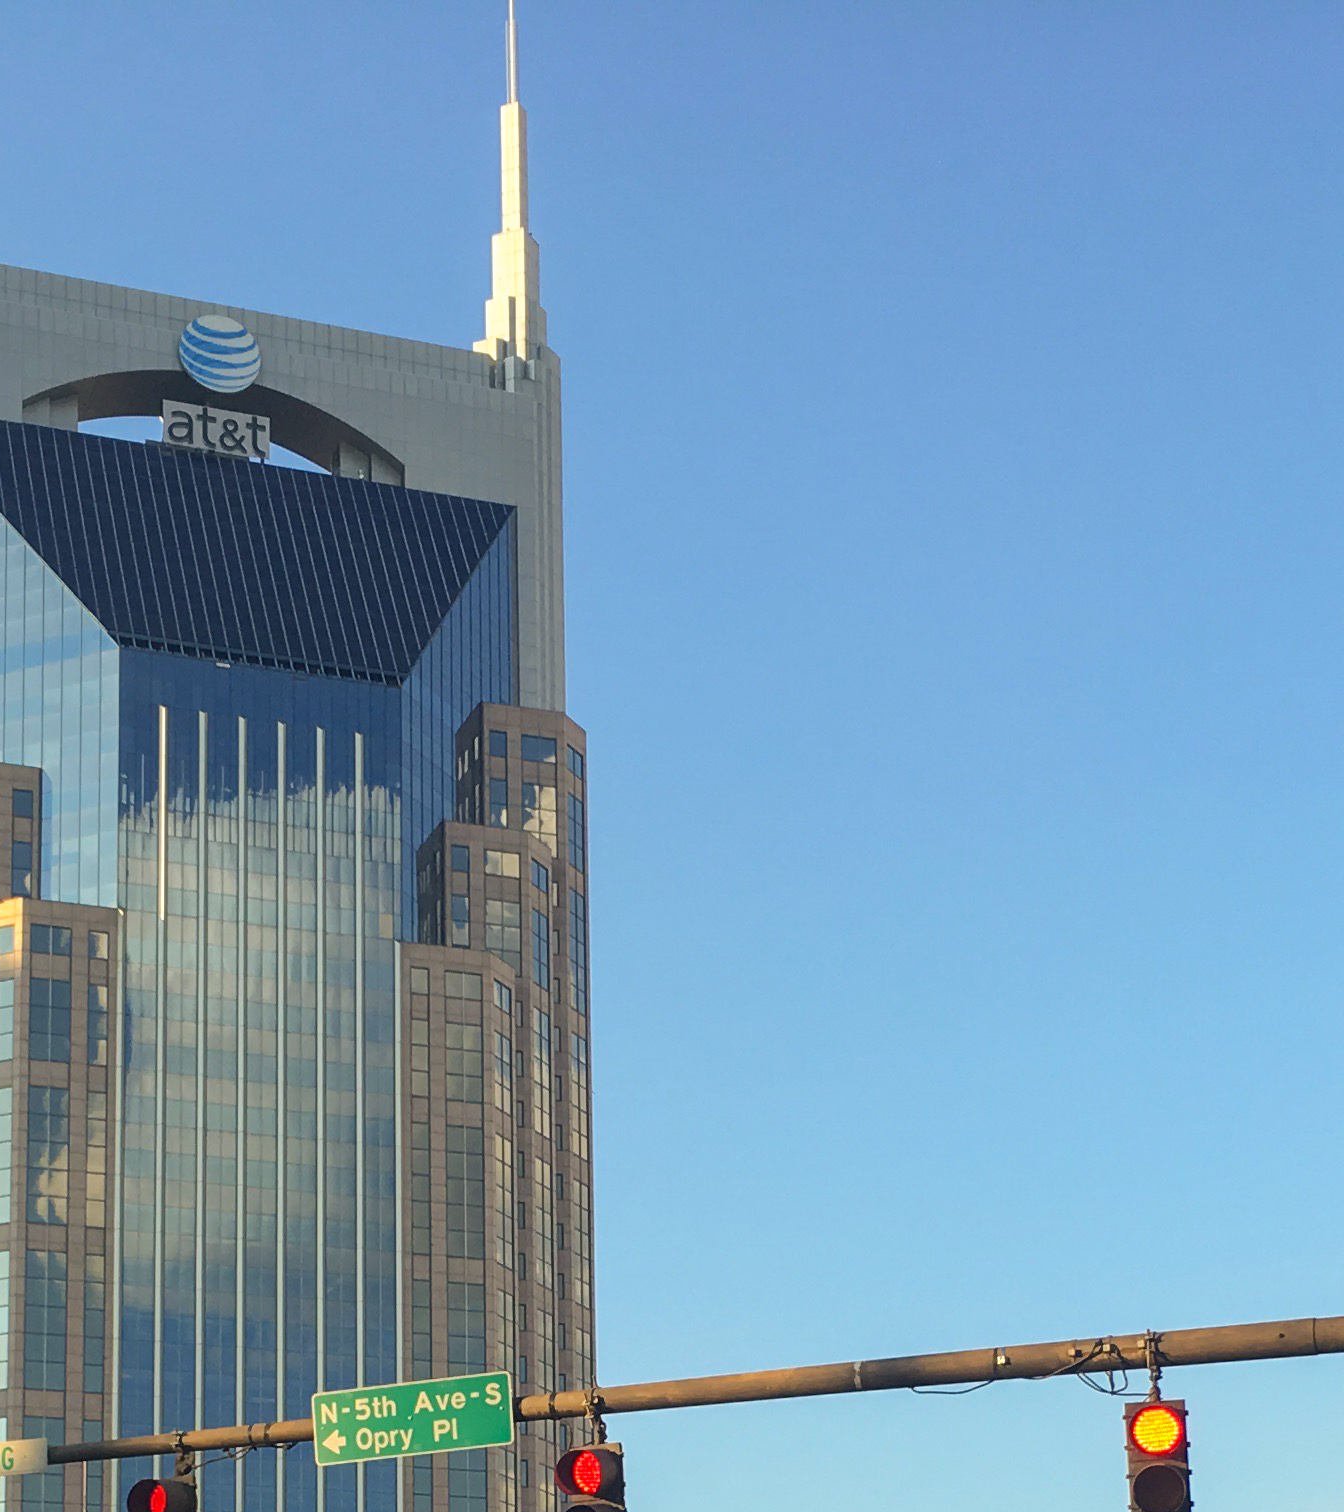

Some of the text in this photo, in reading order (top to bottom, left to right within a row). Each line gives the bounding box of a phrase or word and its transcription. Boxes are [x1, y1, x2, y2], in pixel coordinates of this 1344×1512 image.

[167, 406, 267, 458] at&t
[355, 1417, 459, 1455] Opry Pl
